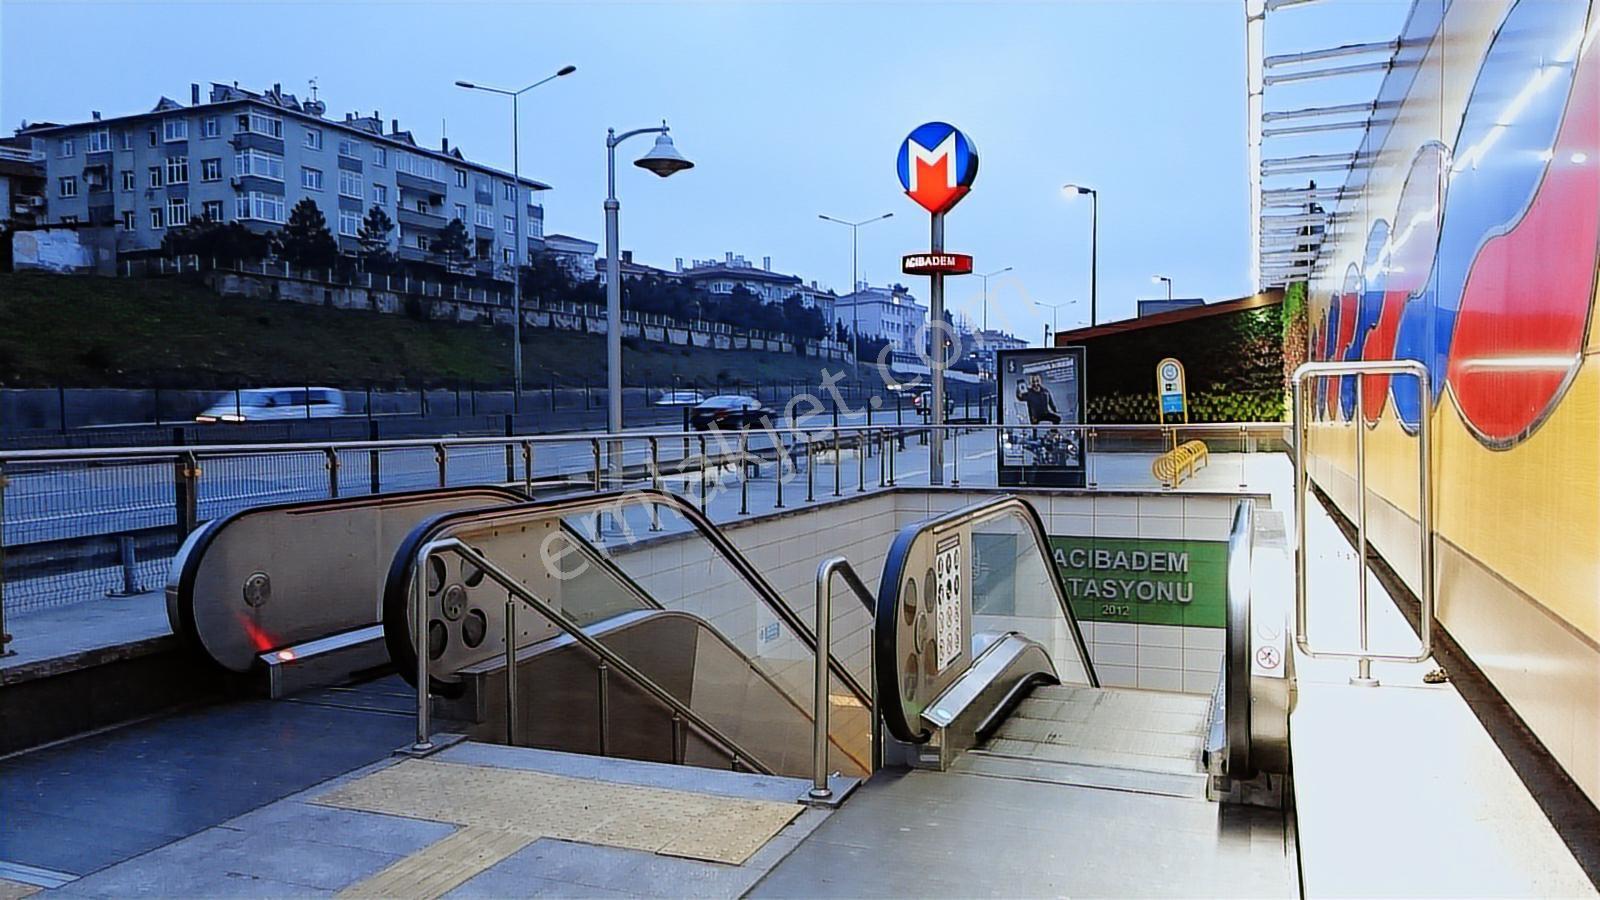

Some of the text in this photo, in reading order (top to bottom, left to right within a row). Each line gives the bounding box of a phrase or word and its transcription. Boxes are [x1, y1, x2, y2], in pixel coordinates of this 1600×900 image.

[905, 256, 956, 268] ACIBADEM
[1054, 548, 1189, 573] ACIBADEM
[1063, 578, 1194, 603] TASYONU
[1102, 604, 1130, 616] 2012
